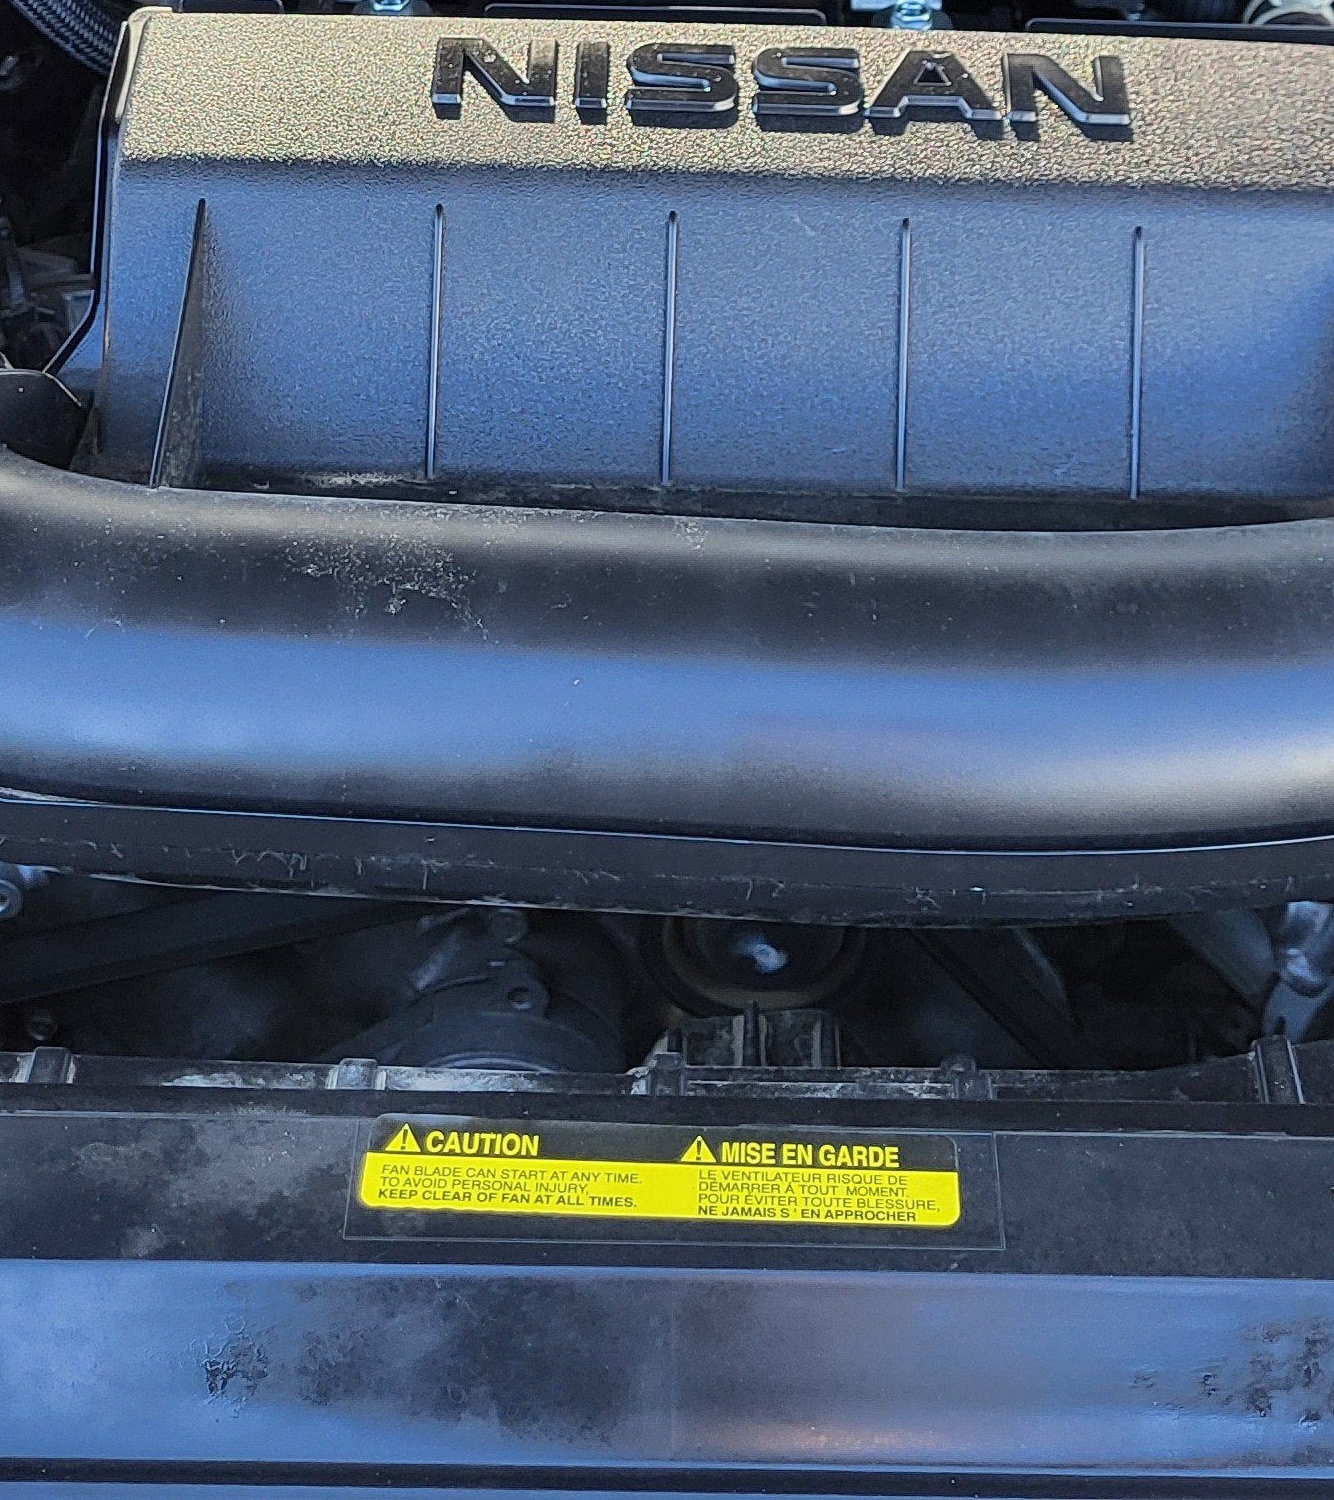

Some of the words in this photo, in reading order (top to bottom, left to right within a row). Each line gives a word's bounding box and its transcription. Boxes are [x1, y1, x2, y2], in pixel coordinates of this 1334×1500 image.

[432, 36, 1132, 132] NISSAN
[426, 1130, 539, 1156] CAUTION
[721, 1141, 776, 1165] MISE
[782, 1143, 813, 1166] EN
[819, 1144, 900, 1168] GARDE
[382, 1164, 410, 1175] FAN
[414, 1165, 462, 1177] BLADE
[466, 1167, 496, 1178] CAN
[501, 1168, 548, 1180] START
[550, 1170, 568, 1181] AT
[571, 1171, 601, 1182] ANY
[605, 1172, 643, 1184] TIME.
[698, 1169, 717, 1181] LE
[722, 1170, 821, 1183] VENTILATEUR
[827, 1173, 884, 1185] RISQUE
[888, 1175, 908, 1186] DE
[380, 1176, 400, 1187] TO
[403, 1177, 447, 1189] AVOID
[452, 1178, 530, 1192] PERSONAL
[535, 1182, 589, 1195] INJURY,
[800, 1184, 838, 1196] TOUT
[846, 1186, 909, 1198] MOMENT.
[378, 1188, 418, 1199] KEEP
[422, 1190, 471, 1202] CLEAR
[477, 1192, 497, 1202] OF
[501, 1192, 530, 1204] FAN
[534, 1194, 553, 1204] AT
[556, 1195, 584, 1206] ALL
[589, 1196, 637, 1208] TIMES.
[698, 1193, 740, 1205] POUR
[802, 1196, 852, 1208] TOUTE
[857, 1198, 940, 1212] BLESSURE,
[698, 1205, 718, 1216] NE
[722, 1206, 776, 1218] JAMAIS
[824, 1209, 917, 1221] APPROCHER
